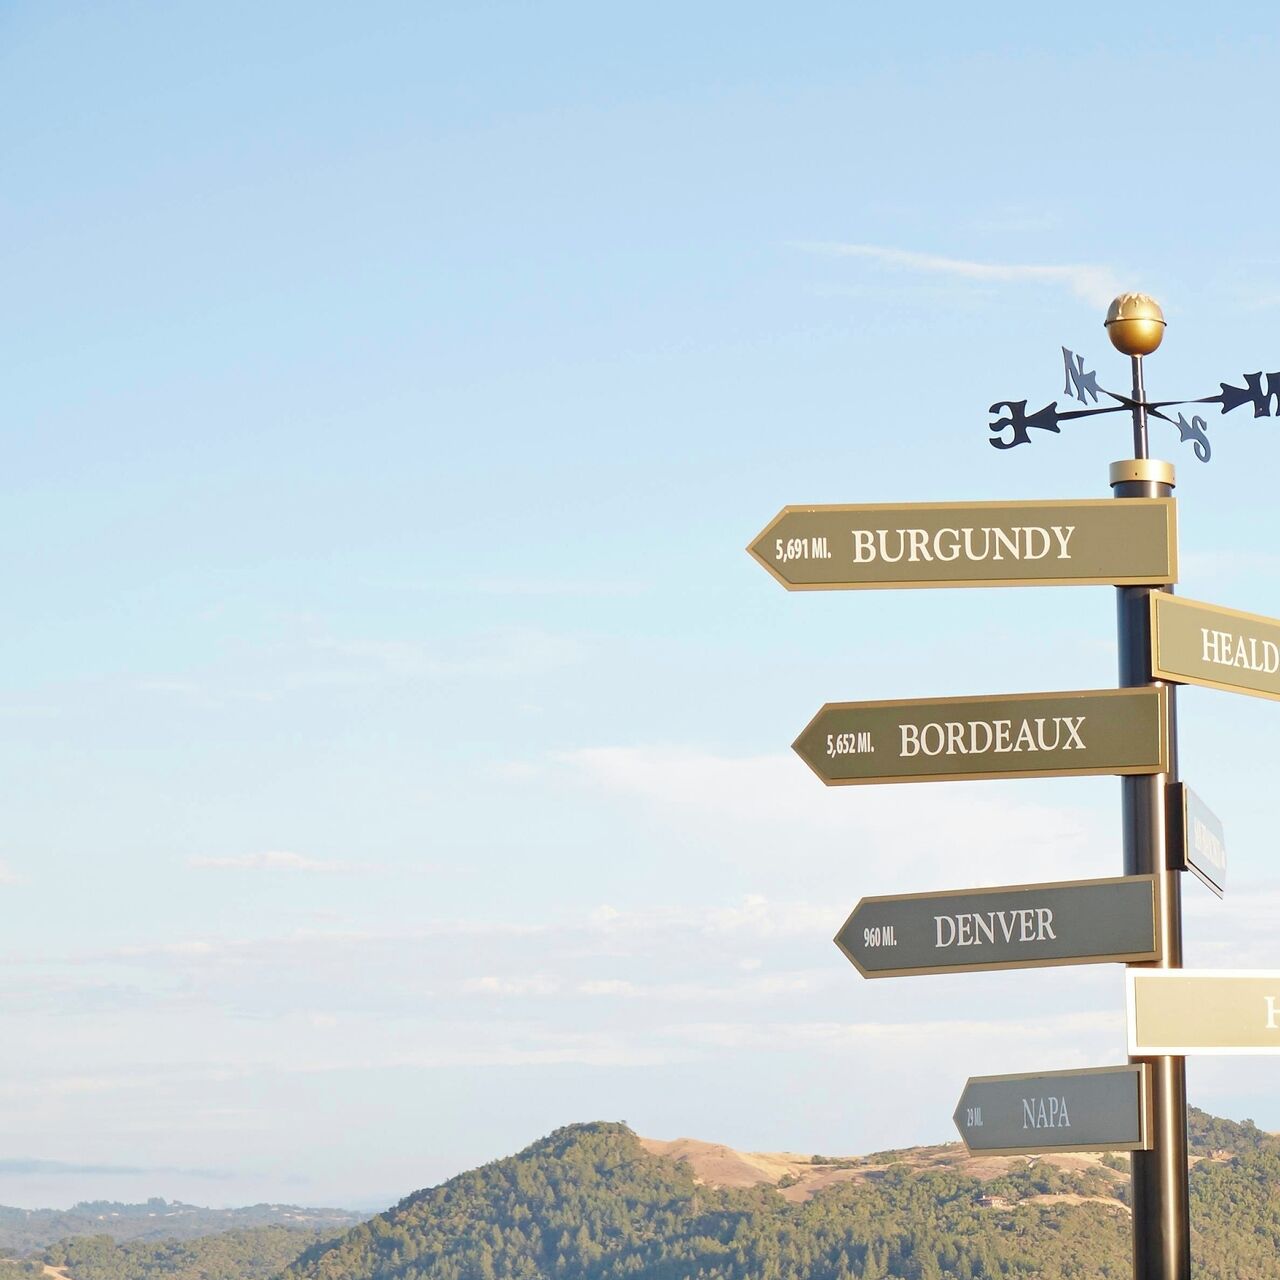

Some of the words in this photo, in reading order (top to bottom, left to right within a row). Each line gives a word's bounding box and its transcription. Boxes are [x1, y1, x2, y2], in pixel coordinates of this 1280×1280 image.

[1062, 346, 1088, 405] N
[1190, 415, 1212, 463] S
[775, 538, 809, 563] 5,691
[812, 536, 832, 560] MI.
[851, 525, 1076, 563] BURGUNDY
[826, 734, 856, 758] 5,652
[857, 731, 875, 753] MI.
[899, 716, 1087, 757] BORDEAUX
[863, 927, 881, 947] 960
[882, 926, 897, 947] MI.
[933, 907, 1057, 948] DENVER
[1022, 1096, 1071, 1129] NAPA
